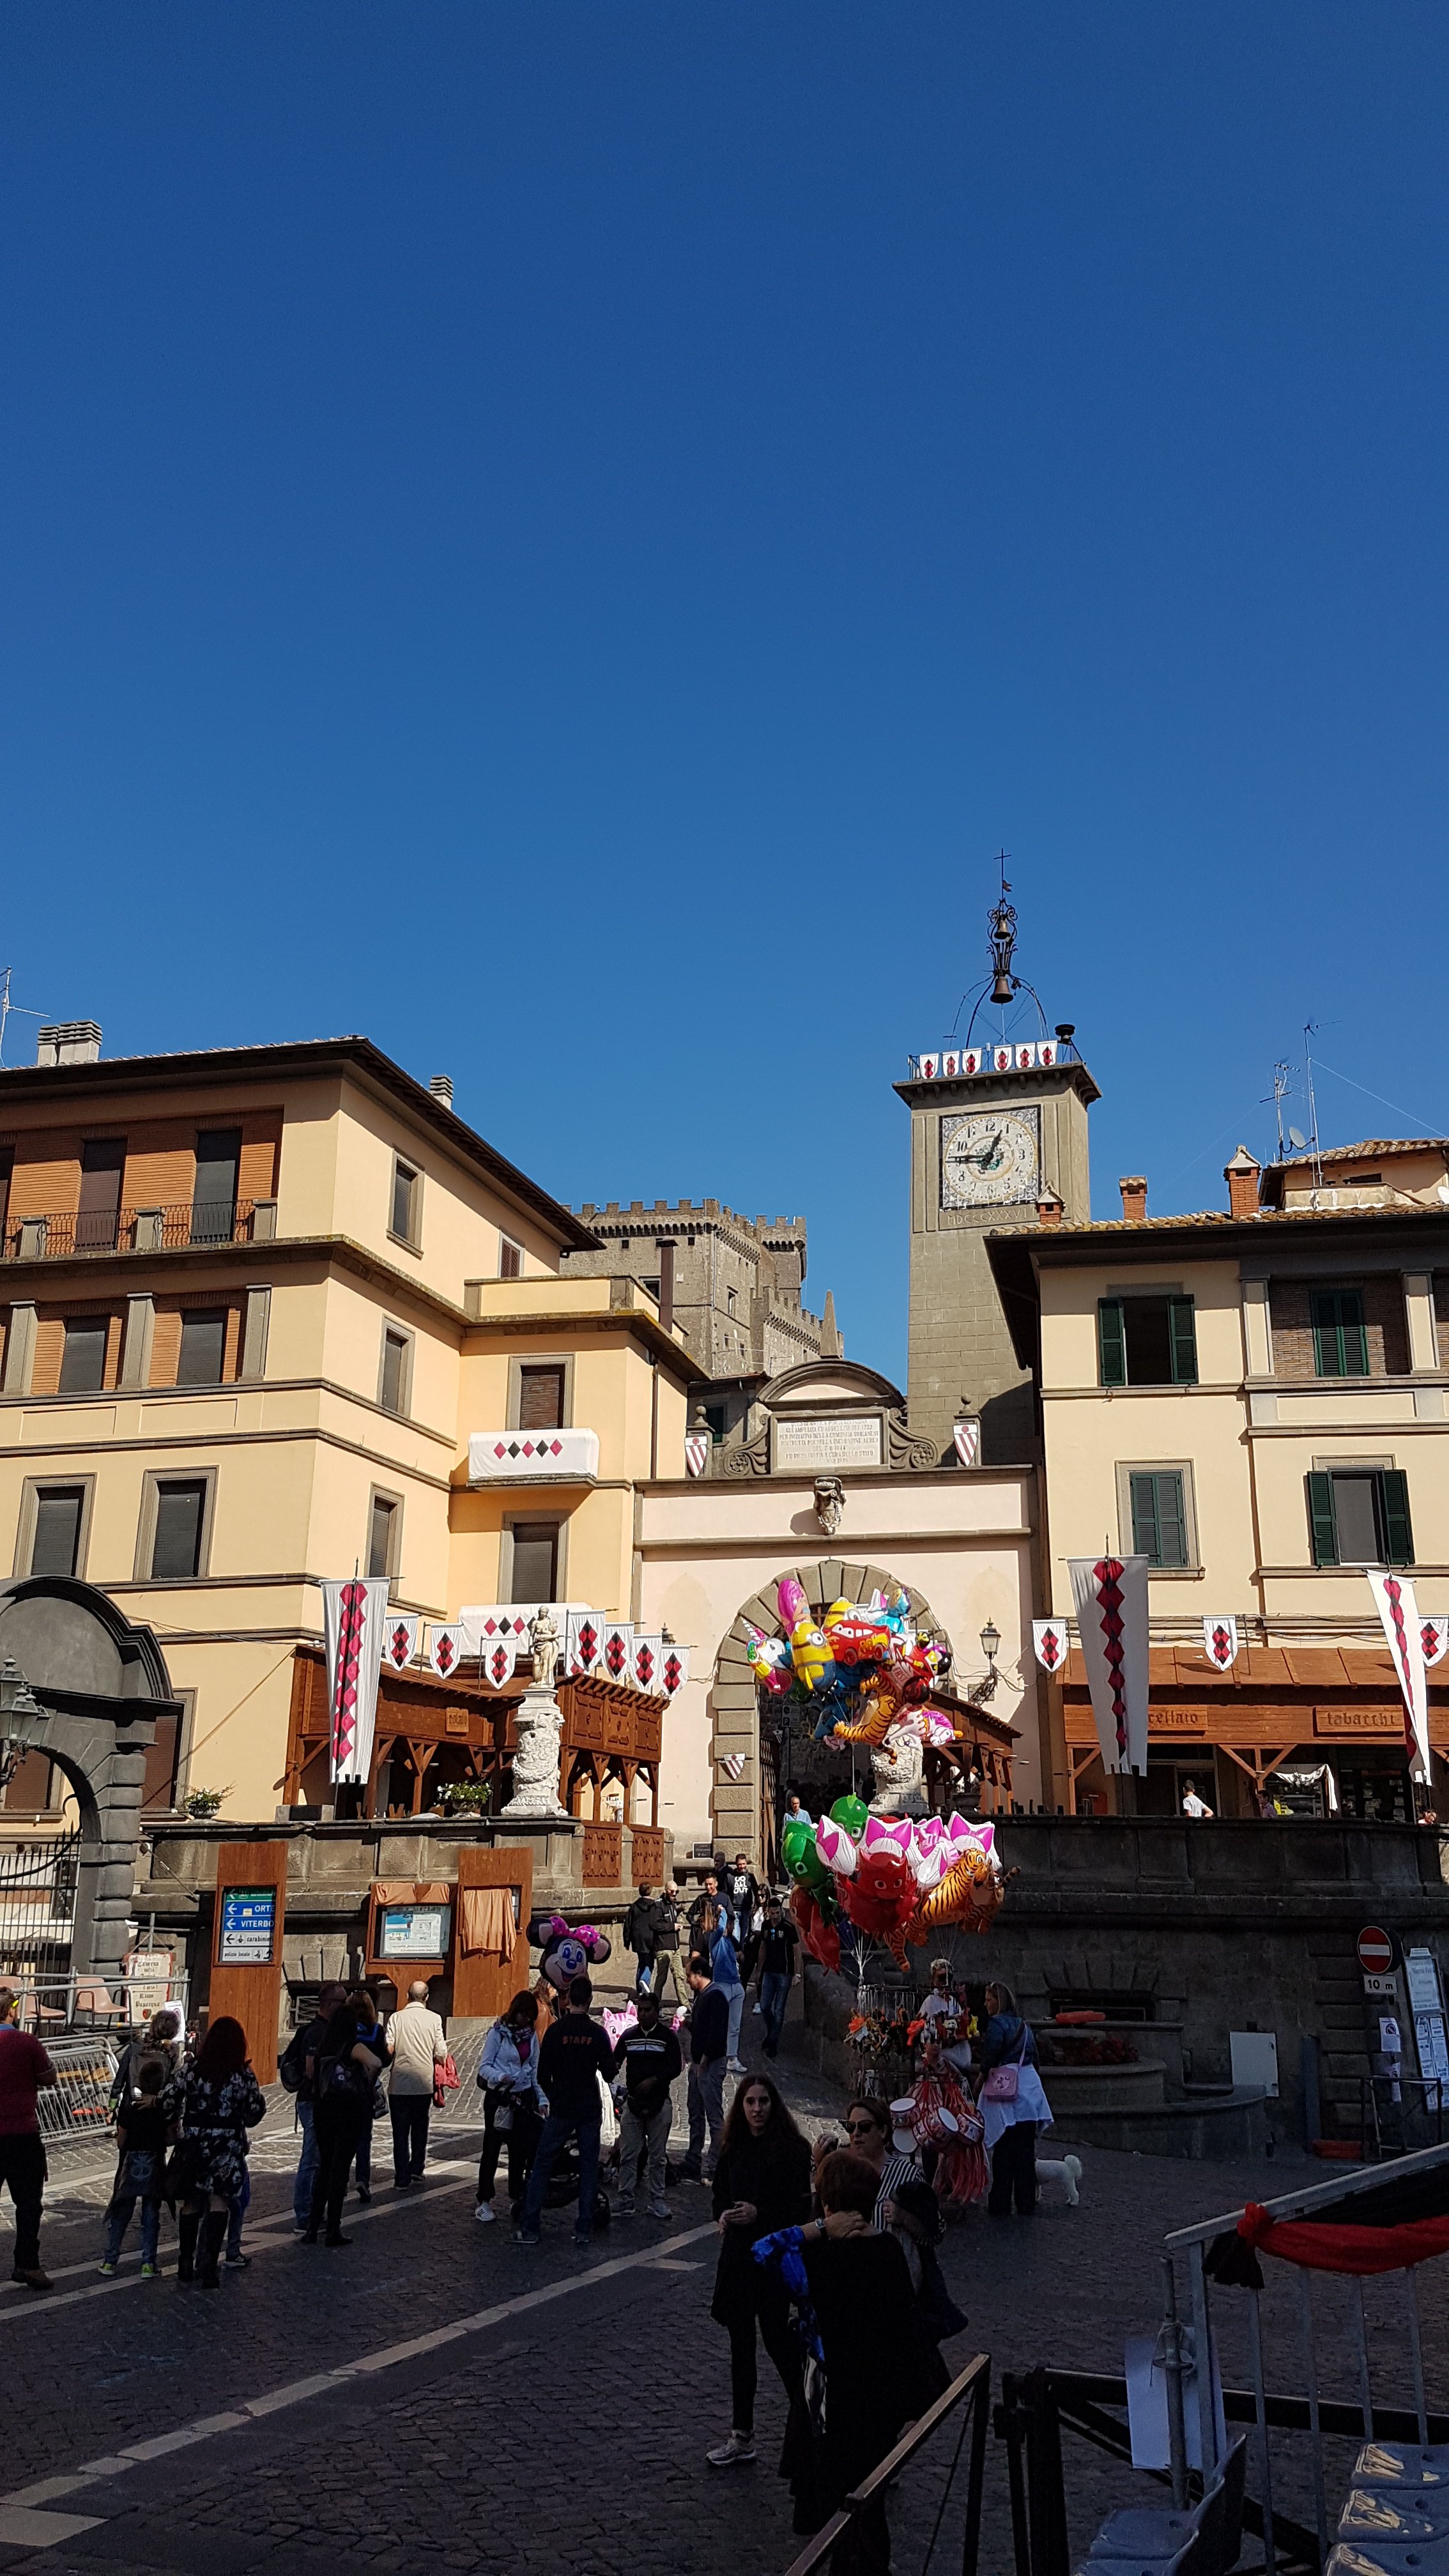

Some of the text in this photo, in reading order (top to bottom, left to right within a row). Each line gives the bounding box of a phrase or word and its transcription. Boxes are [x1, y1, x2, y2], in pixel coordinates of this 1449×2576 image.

[986, 1122, 995, 1131] 12
[1006, 1123, 1009, 1134] 1
[957, 1141, 968, 1152] 10
[1018, 1149, 1025, 1160] 3
[958, 1170, 965, 1182] 8
[970, 1182, 977, 1192] 7
[1004, 1177, 1011, 1189] 5
[987, 1184, 996, 1196] 6
[1148, 1710, 1199, 1724] cellaio
[1327, 1712, 1395, 1726] tabacchi
[1368, 1979, 1380, 1989] 10
[562, 2035, 593, 2045] STAFF
